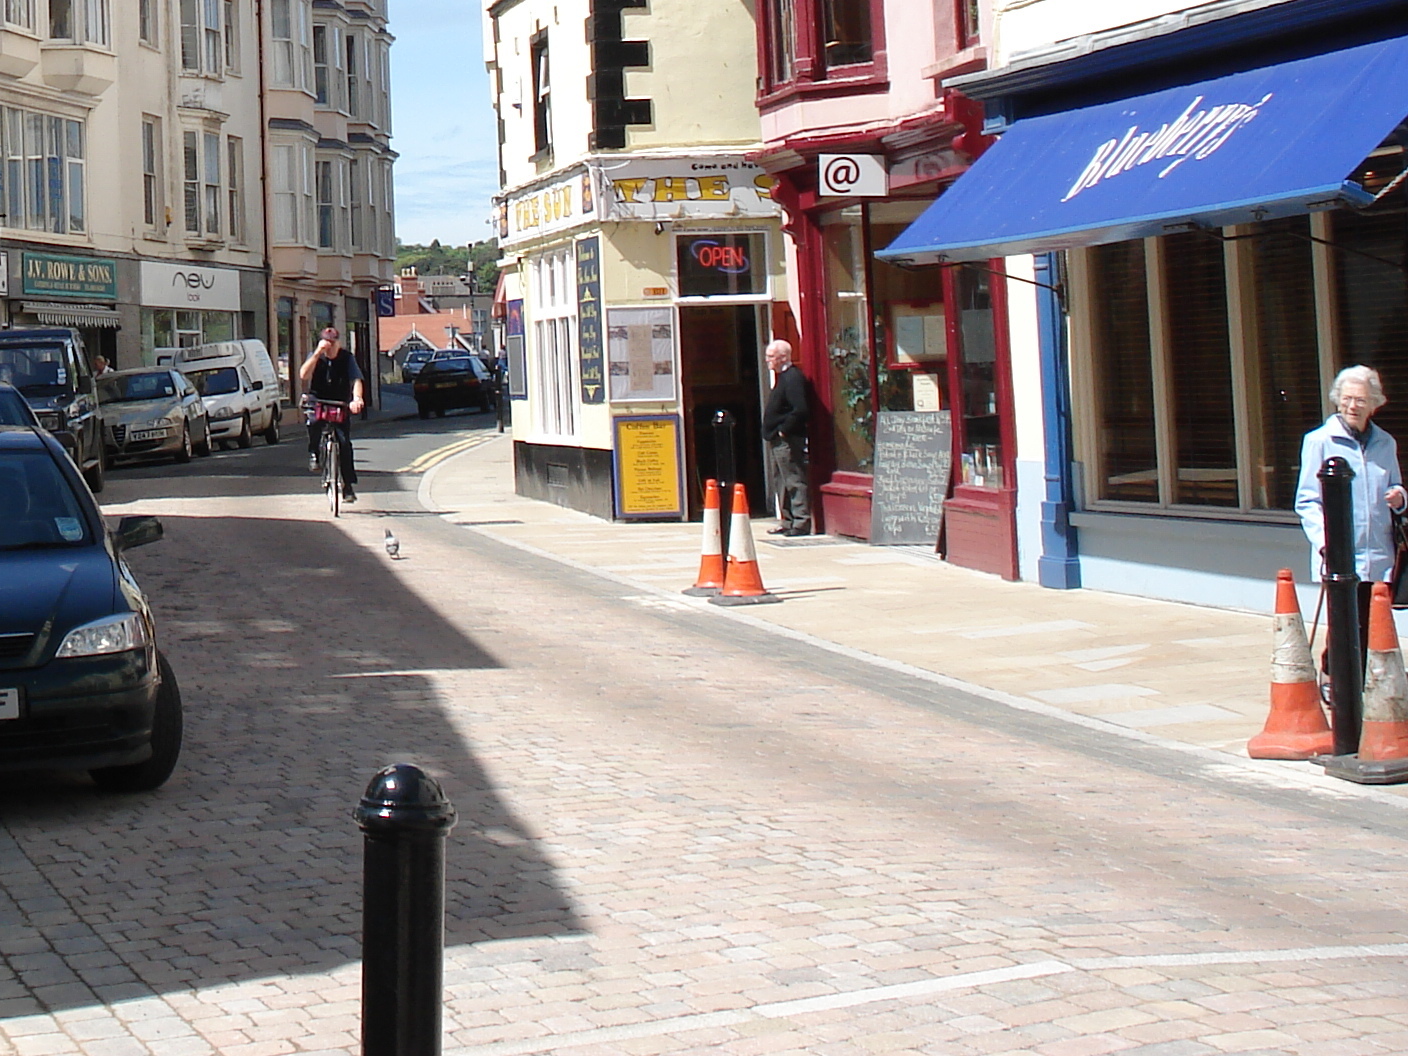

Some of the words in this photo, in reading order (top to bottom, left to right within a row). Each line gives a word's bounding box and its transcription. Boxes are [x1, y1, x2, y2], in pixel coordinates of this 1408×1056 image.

[612, 174, 732, 204] THE
[824, 156, 861, 194] @
[514, 195, 540, 232] THE
[543, 184, 573, 224] SUN
[47, 261, 76, 281] ROWE
[78, 263, 86, 282] &
[698, 246, 745, 268] OPEN
